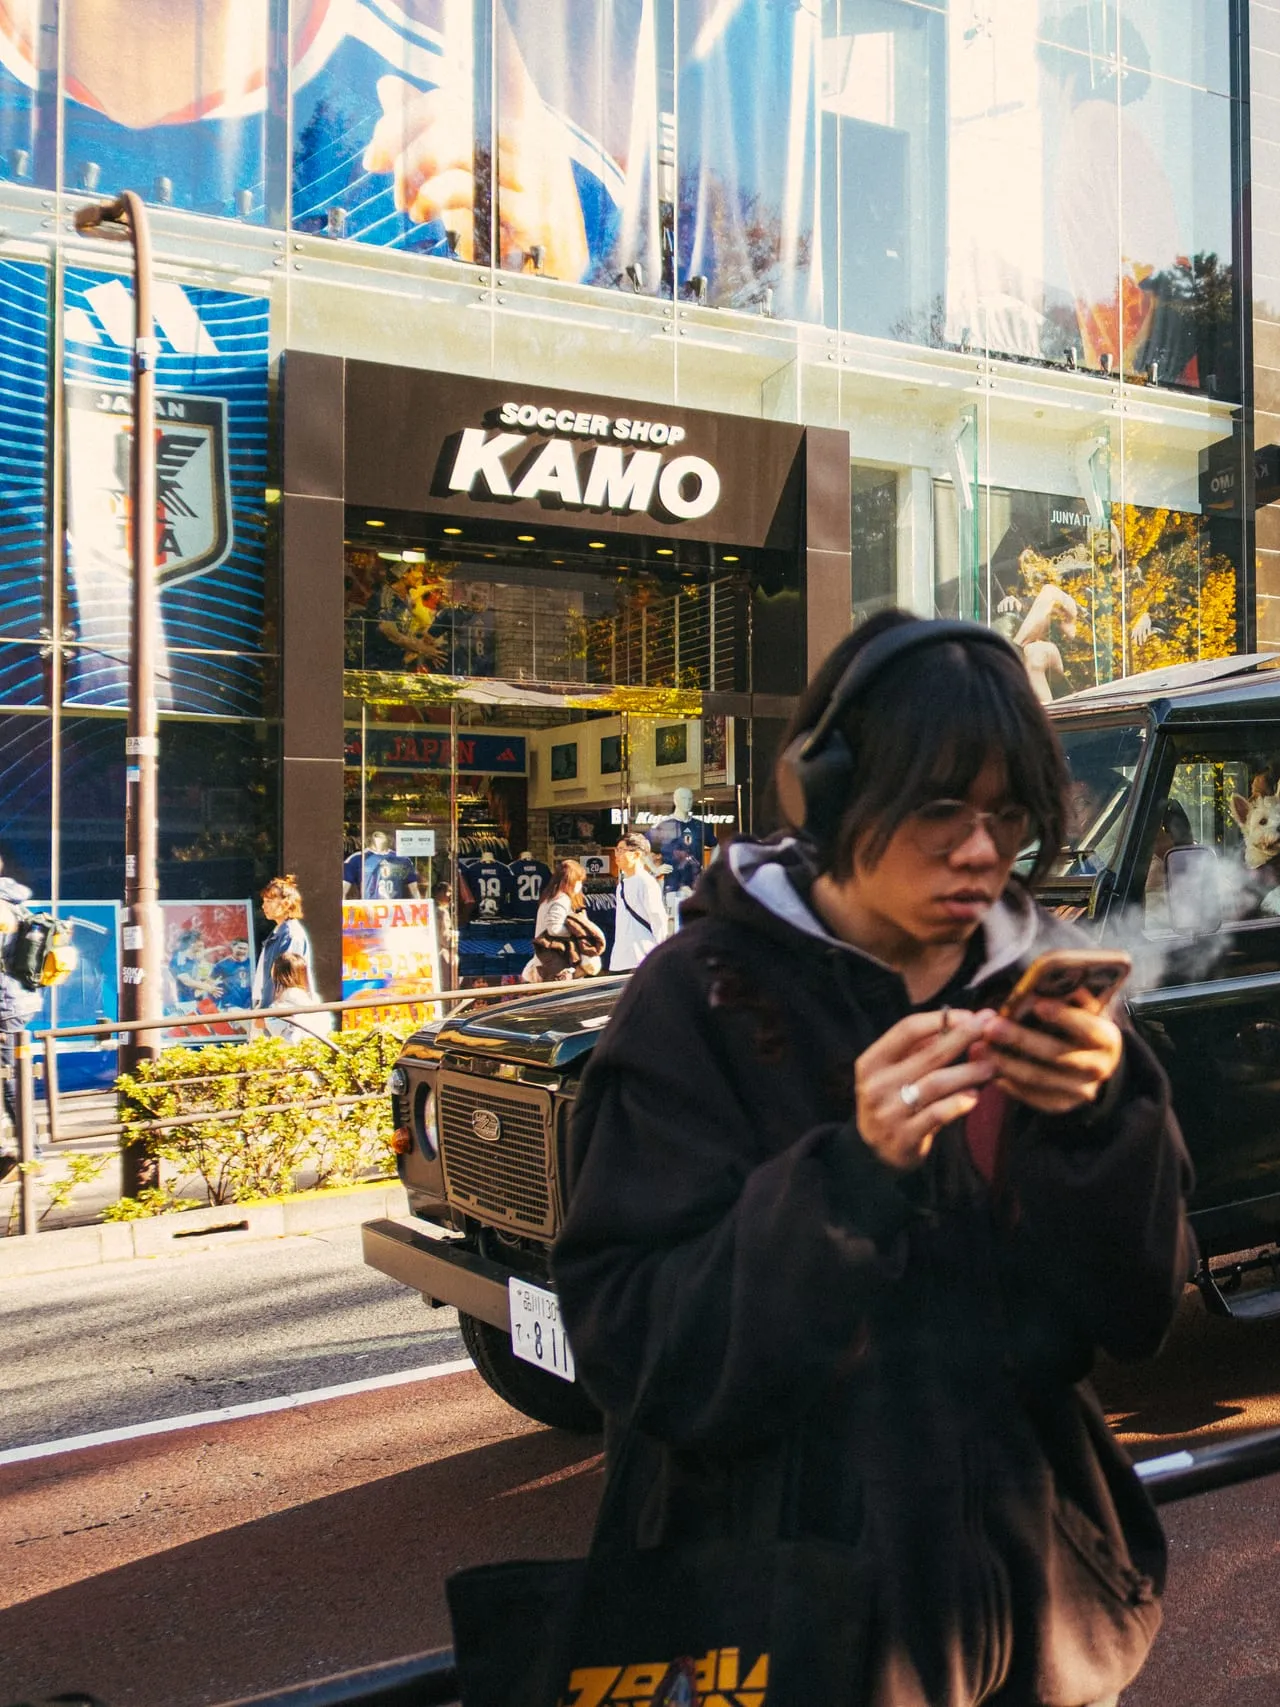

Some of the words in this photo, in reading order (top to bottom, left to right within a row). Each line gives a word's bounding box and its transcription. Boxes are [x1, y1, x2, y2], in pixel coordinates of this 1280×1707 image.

[97, 394, 185, 418] JAAN
[500, 403, 609, 436] SOCCER
[612, 418, 685, 446] SHOP
[449, 428, 720, 519] KAMO
[1051, 510, 1080, 526] JUNYA
[517, 874, 542, 901] 20
